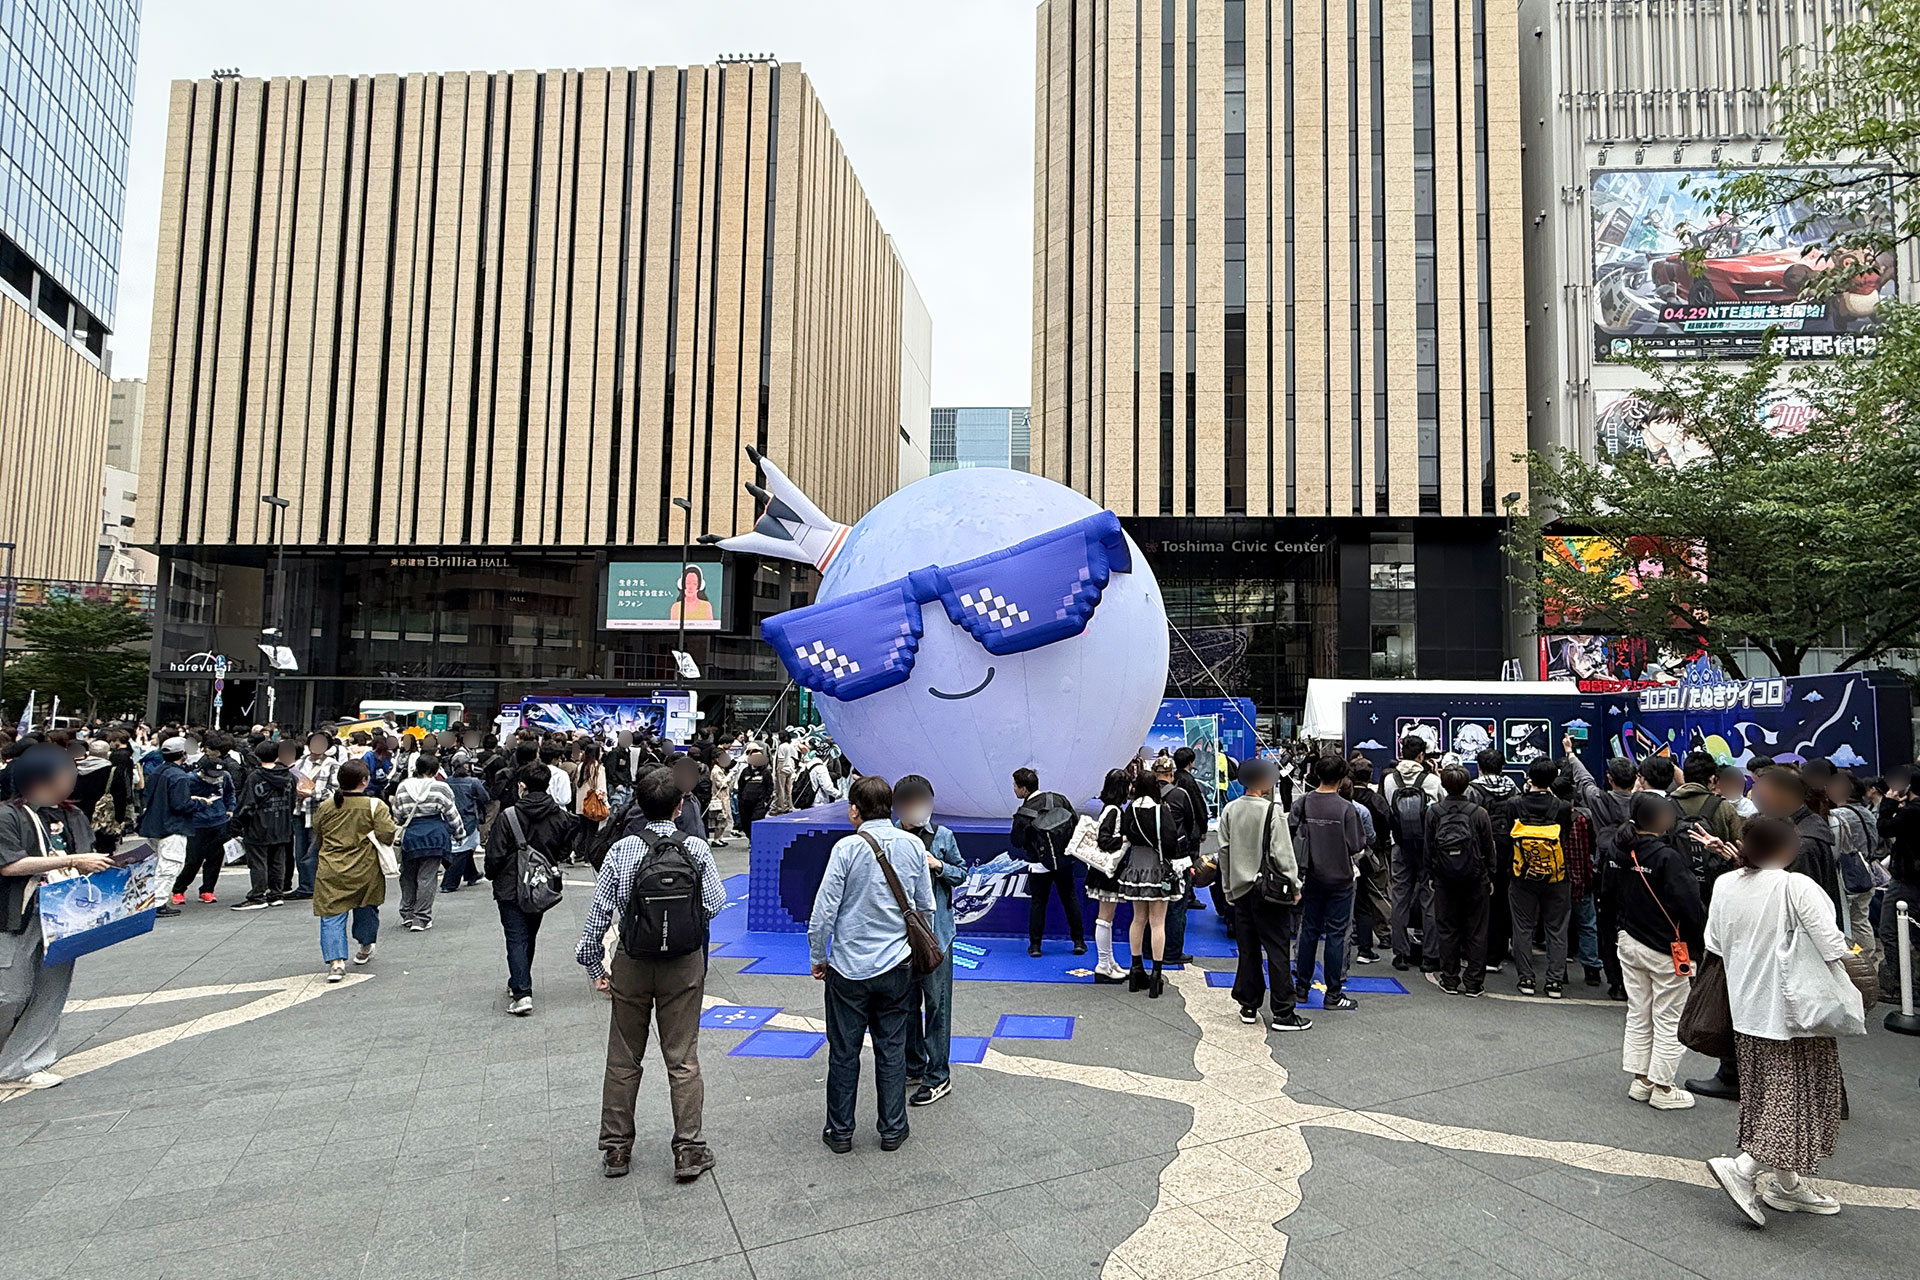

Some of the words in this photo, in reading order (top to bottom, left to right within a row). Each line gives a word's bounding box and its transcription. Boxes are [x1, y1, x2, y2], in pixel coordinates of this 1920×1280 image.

[1161, 540, 1225, 552] Toshima
[1231, 540, 1268, 552] Civic
[1274, 540, 1326, 553] Center
[427, 556, 477, 567] Brillia
[480, 558, 510, 567] HALL
